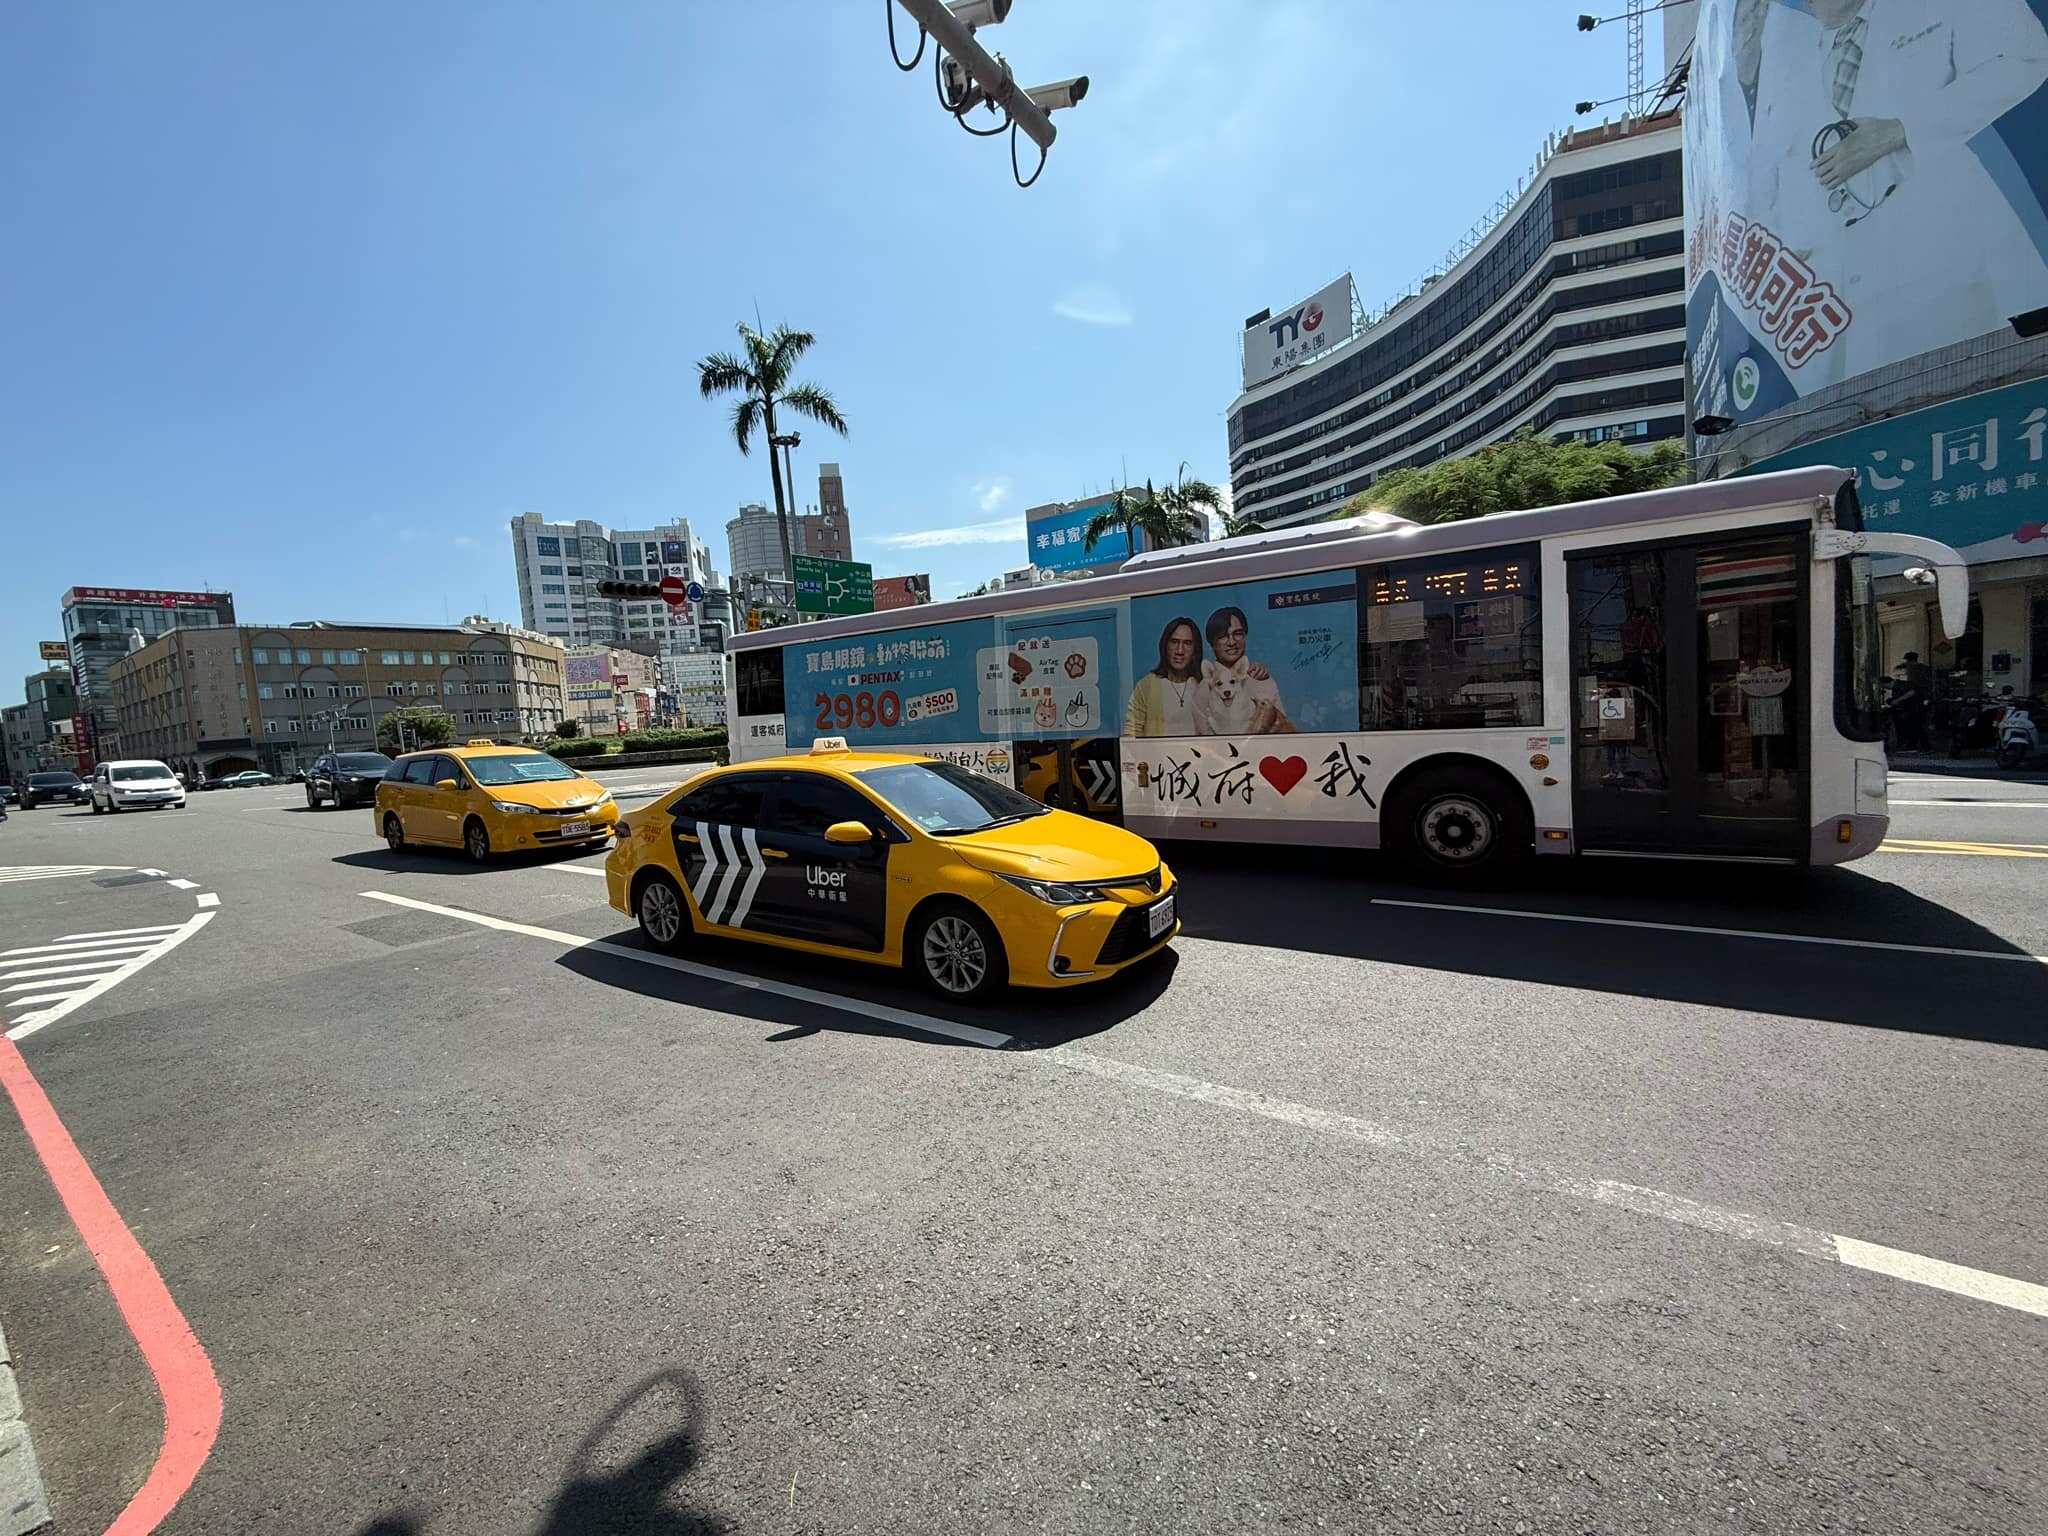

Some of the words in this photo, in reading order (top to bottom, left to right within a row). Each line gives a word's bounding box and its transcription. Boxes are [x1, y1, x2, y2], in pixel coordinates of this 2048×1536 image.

[1721, 213, 1848, 366] 長期可行
[1929, 472, 2048, 507] 全新機車
[806, 647, 865, 673] 寶島眼鏡
[876, 638, 945, 666] 動物聯萌
[860, 670, 901, 684] PENTAX
[815, 690, 900, 730] 2980
[925, 692, 954, 709] $500
[824, 740, 841, 748] Uber
[1314, 742, 1377, 809] 我
[806, 865, 846, 887] Uber
[808, 888, 847, 902] 中華衛星
